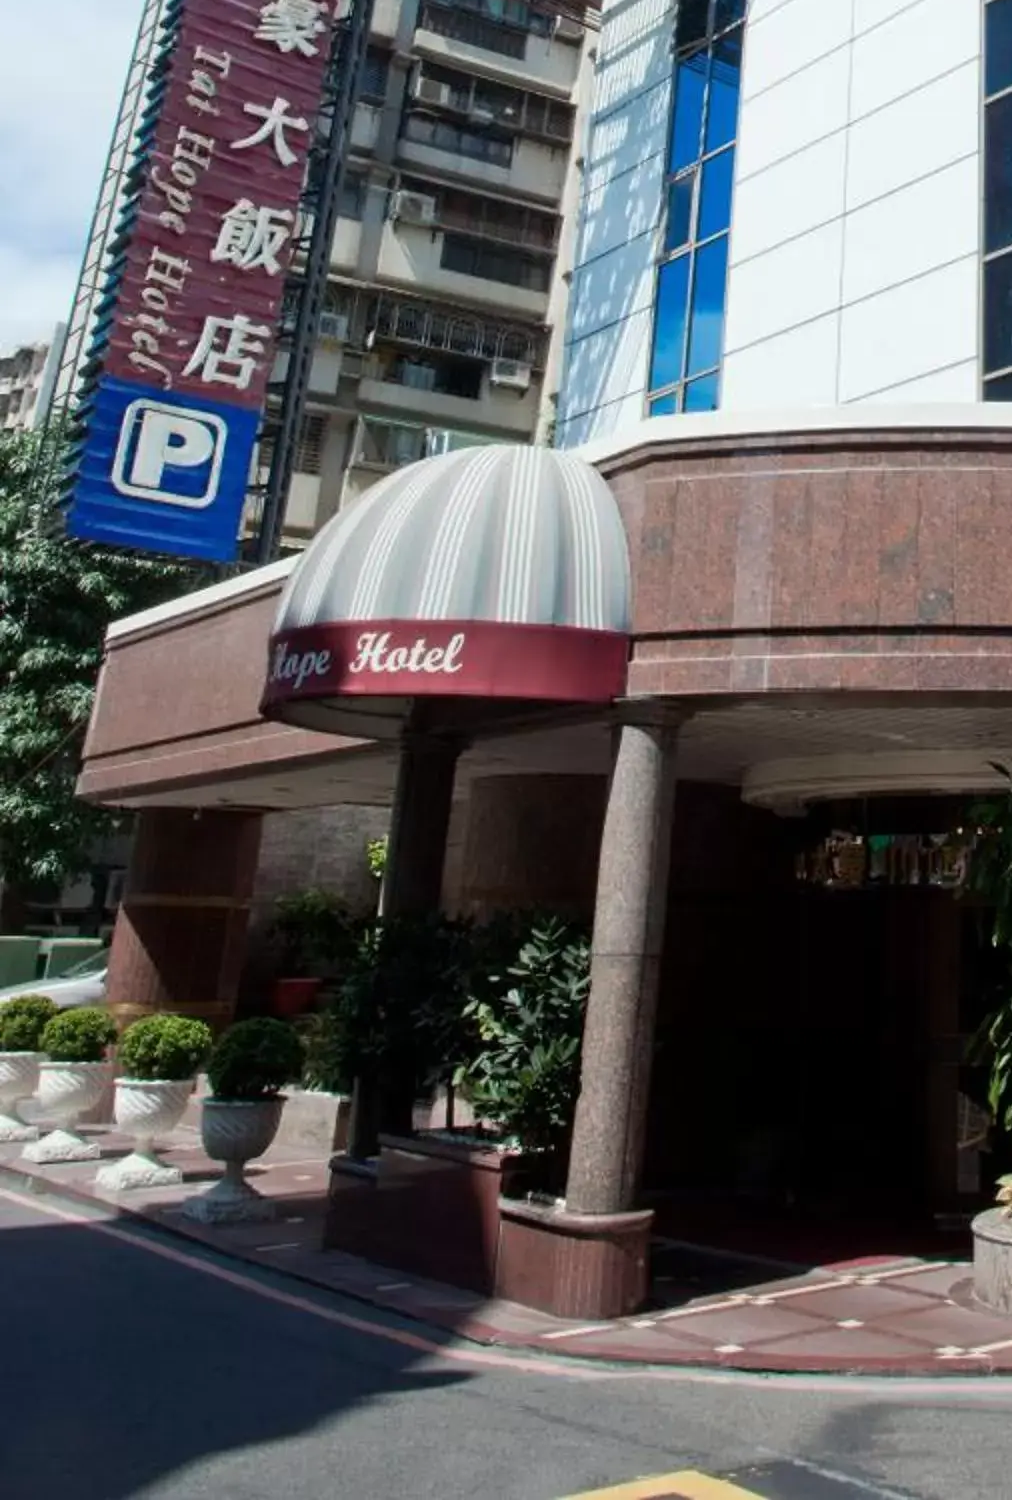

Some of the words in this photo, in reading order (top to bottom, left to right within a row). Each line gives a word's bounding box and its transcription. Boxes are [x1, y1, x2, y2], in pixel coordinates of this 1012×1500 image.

[185, 45, 233, 118] Tai
[151, 125, 216, 236] Hope
[127, 244, 194, 390] Hotel
[129, 409, 216, 490] P
[349, 632, 465, 674] Hotel
